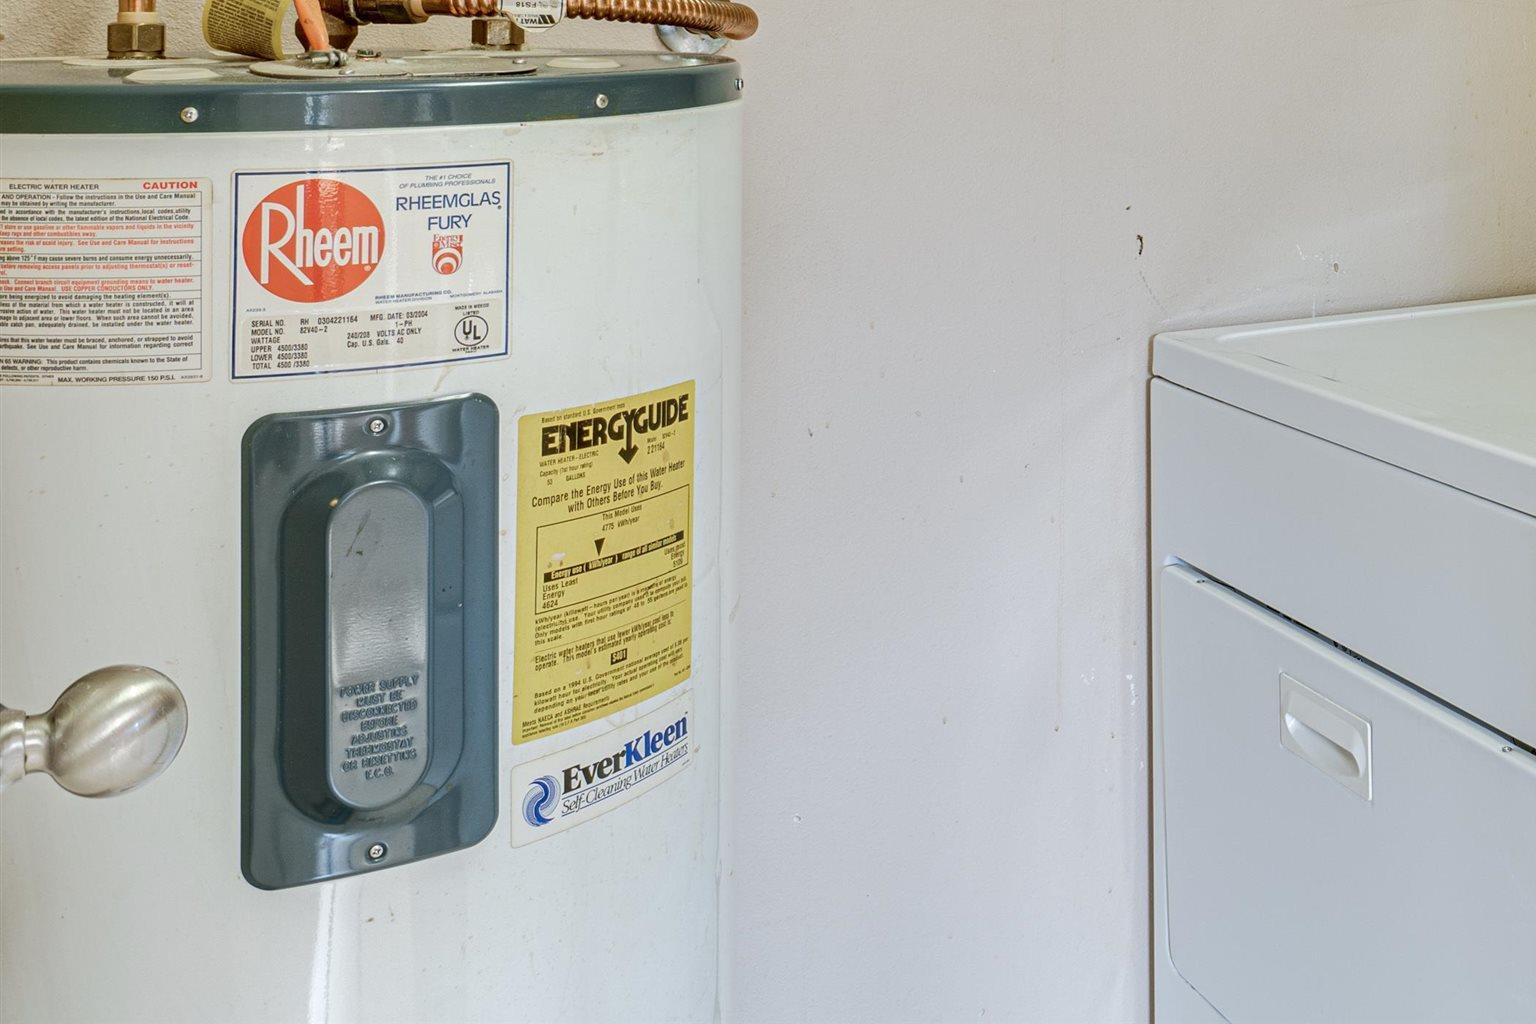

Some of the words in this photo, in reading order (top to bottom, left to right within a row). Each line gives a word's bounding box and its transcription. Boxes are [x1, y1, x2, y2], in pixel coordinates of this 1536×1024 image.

[143, 181, 198, 190] CAUTION
[410, 181, 444, 189] PLUMBING
[444, 178, 496, 187] PROFESSIONALS
[395, 191, 501, 211] RHEEMGLAS
[428, 213, 473, 231] FURY
[260, 184, 379, 286] Rheem
[387, 312, 404, 320] DATE:
[406, 311, 428, 319] 03/2004
[376, 329, 395, 337] VOLTS
[397, 328, 405, 336] AC
[406, 327, 422, 335] ONLY
[277, 343, 308, 352] 4500/3380
[347, 340, 360, 348] Cap.
[251, 354, 273, 362] LOWER
[277, 352, 308, 360] 4500/3380
[541, 393, 689, 457] ENERGYGUIDE
[532, 492, 569, 508] Compare
[571, 488, 584, 499] the
[586, 481, 611, 496] Energy
[613, 478, 626, 489] Use
[628, 474, 635, 485] of
[636, 471, 648, 482] this
[650, 466, 667, 478] Water
[668, 460, 686, 473] Heater
[568, 500, 584, 513] with
[587, 496, 611, 509] Others
[613, 489, 635, 502] Before
[636, 483, 649, 495] You
[602, 512, 613, 521] This
[614, 508, 630, 519] Model
[542, 584, 559, 592] Uses
[561, 577, 578, 588] Least
[542, 589, 565, 601] Energy
[542, 600, 559, 610] 4624
[535, 652, 557, 664] Electric
[558, 647, 573, 658] water
[340, 681, 376, 698] POWER
[379, 674, 420, 691] SUPPLY
[356, 692, 386, 707] MUST
[341, 698, 418, 723] DISCONNECTED
[351, 725, 408, 746] ADJUSTING
[344, 737, 414, 759] THERMOSTAT
[562, 716, 688, 795] EverKleen
[342, 760, 358, 773] OR
[361, 748, 418, 769] RESETTING
[561, 773, 632, 814] Self-Cleaning
[634, 759, 660, 782] Water
[660, 742, 688, 767] Heaters
